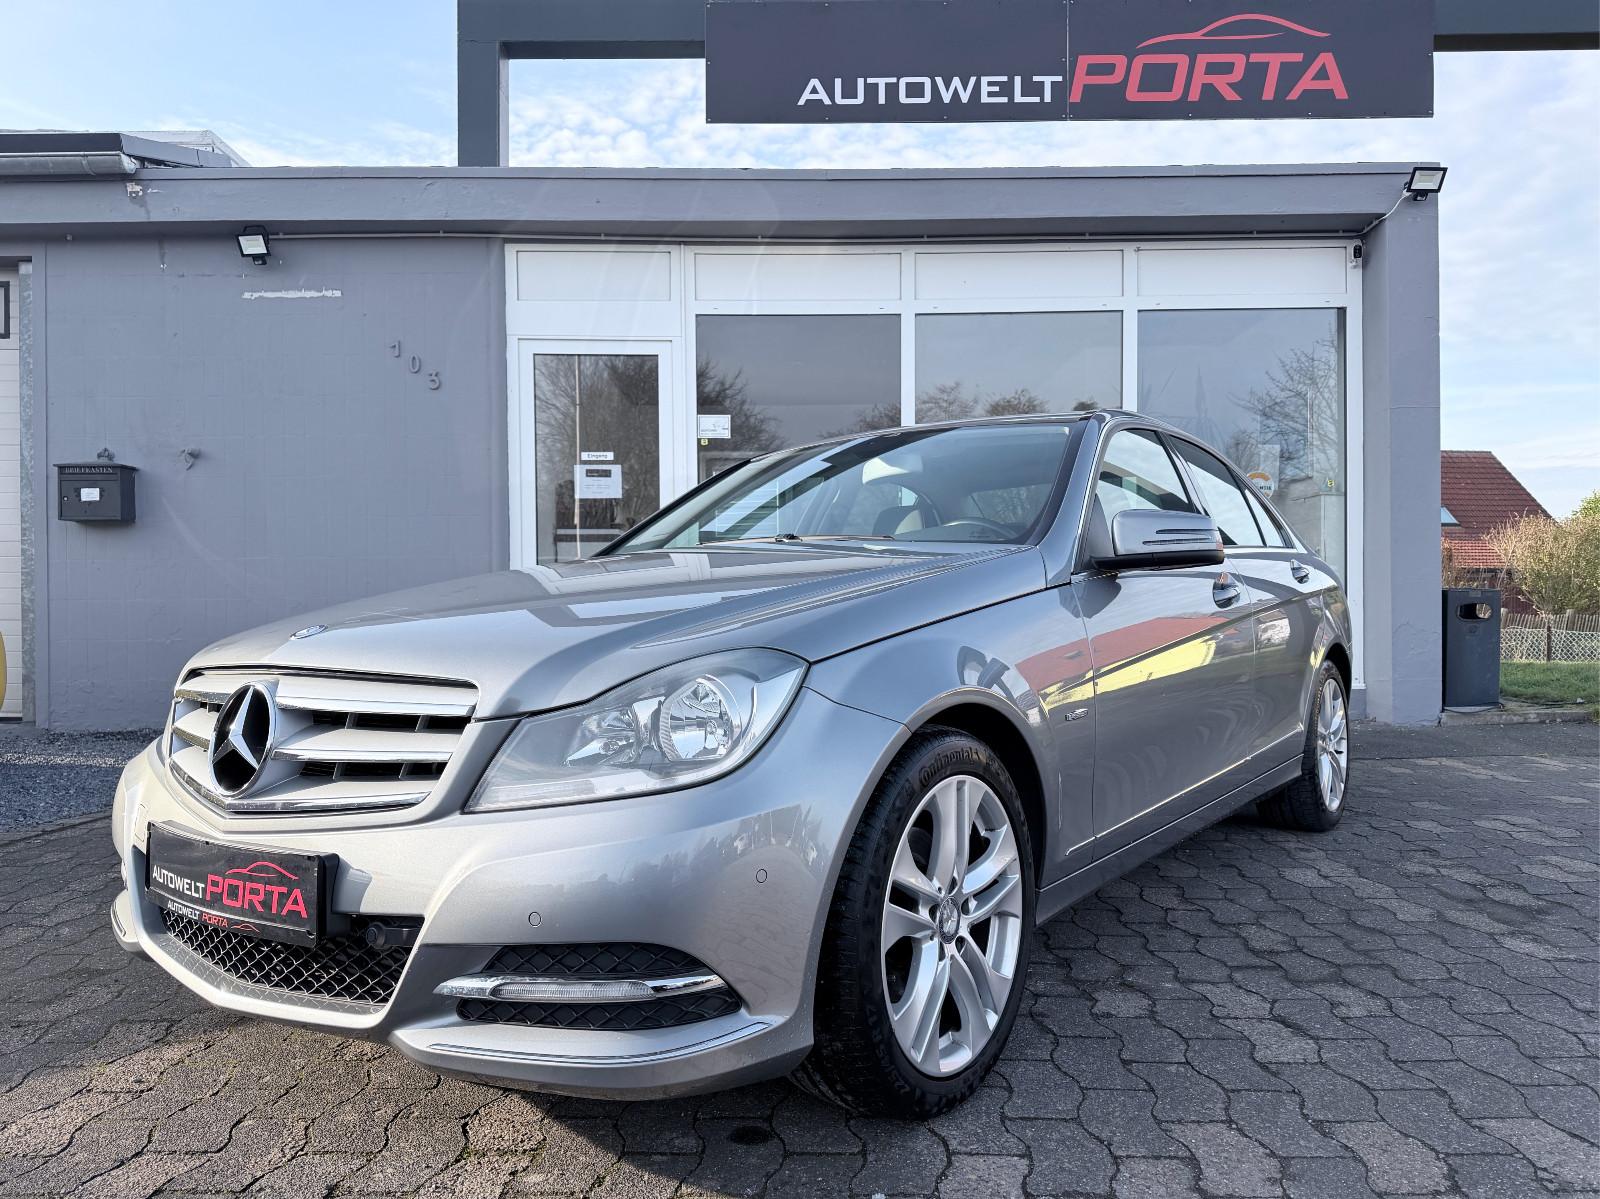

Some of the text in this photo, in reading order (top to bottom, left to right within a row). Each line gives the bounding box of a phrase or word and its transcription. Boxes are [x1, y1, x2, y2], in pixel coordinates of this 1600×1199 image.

[797, 52, 1349, 105] AUTOWELT PORTA
[388, 340, 442, 391] 103
[152, 864, 308, 919] AUTOWELT PORTA
[167, 900, 229, 928] AUTOWELT PORTA
